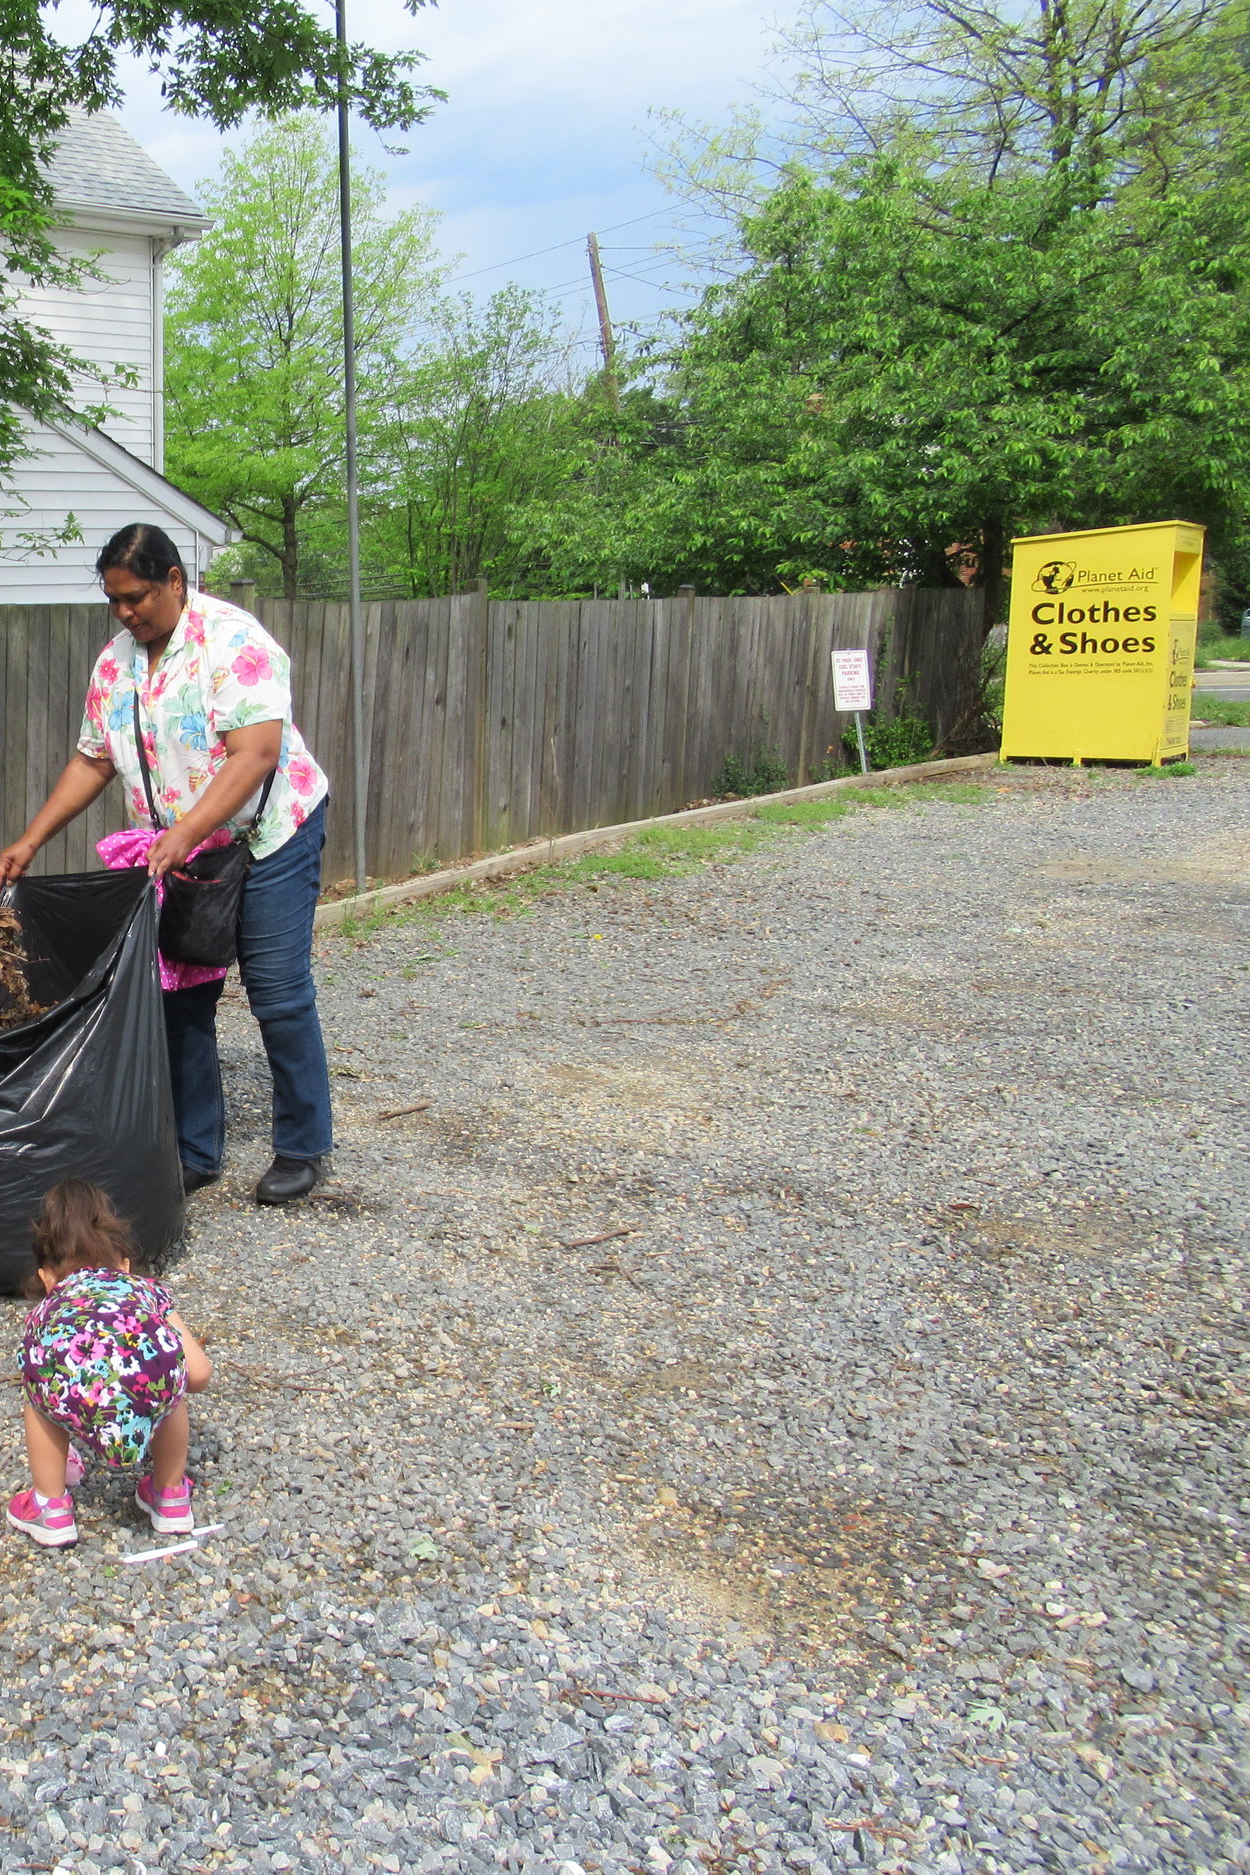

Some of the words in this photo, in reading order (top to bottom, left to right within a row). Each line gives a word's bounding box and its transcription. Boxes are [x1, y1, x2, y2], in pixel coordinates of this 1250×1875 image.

[1078, 570, 1123, 582] Planet
[1128, 568, 1154, 580] Aid
[1082, 585, 1149, 593] www.planetaid.org
[1031, 601, 1157, 625] Clothes
[1030, 633, 1053, 655] &
[1059, 632, 1156, 655] Shoes
